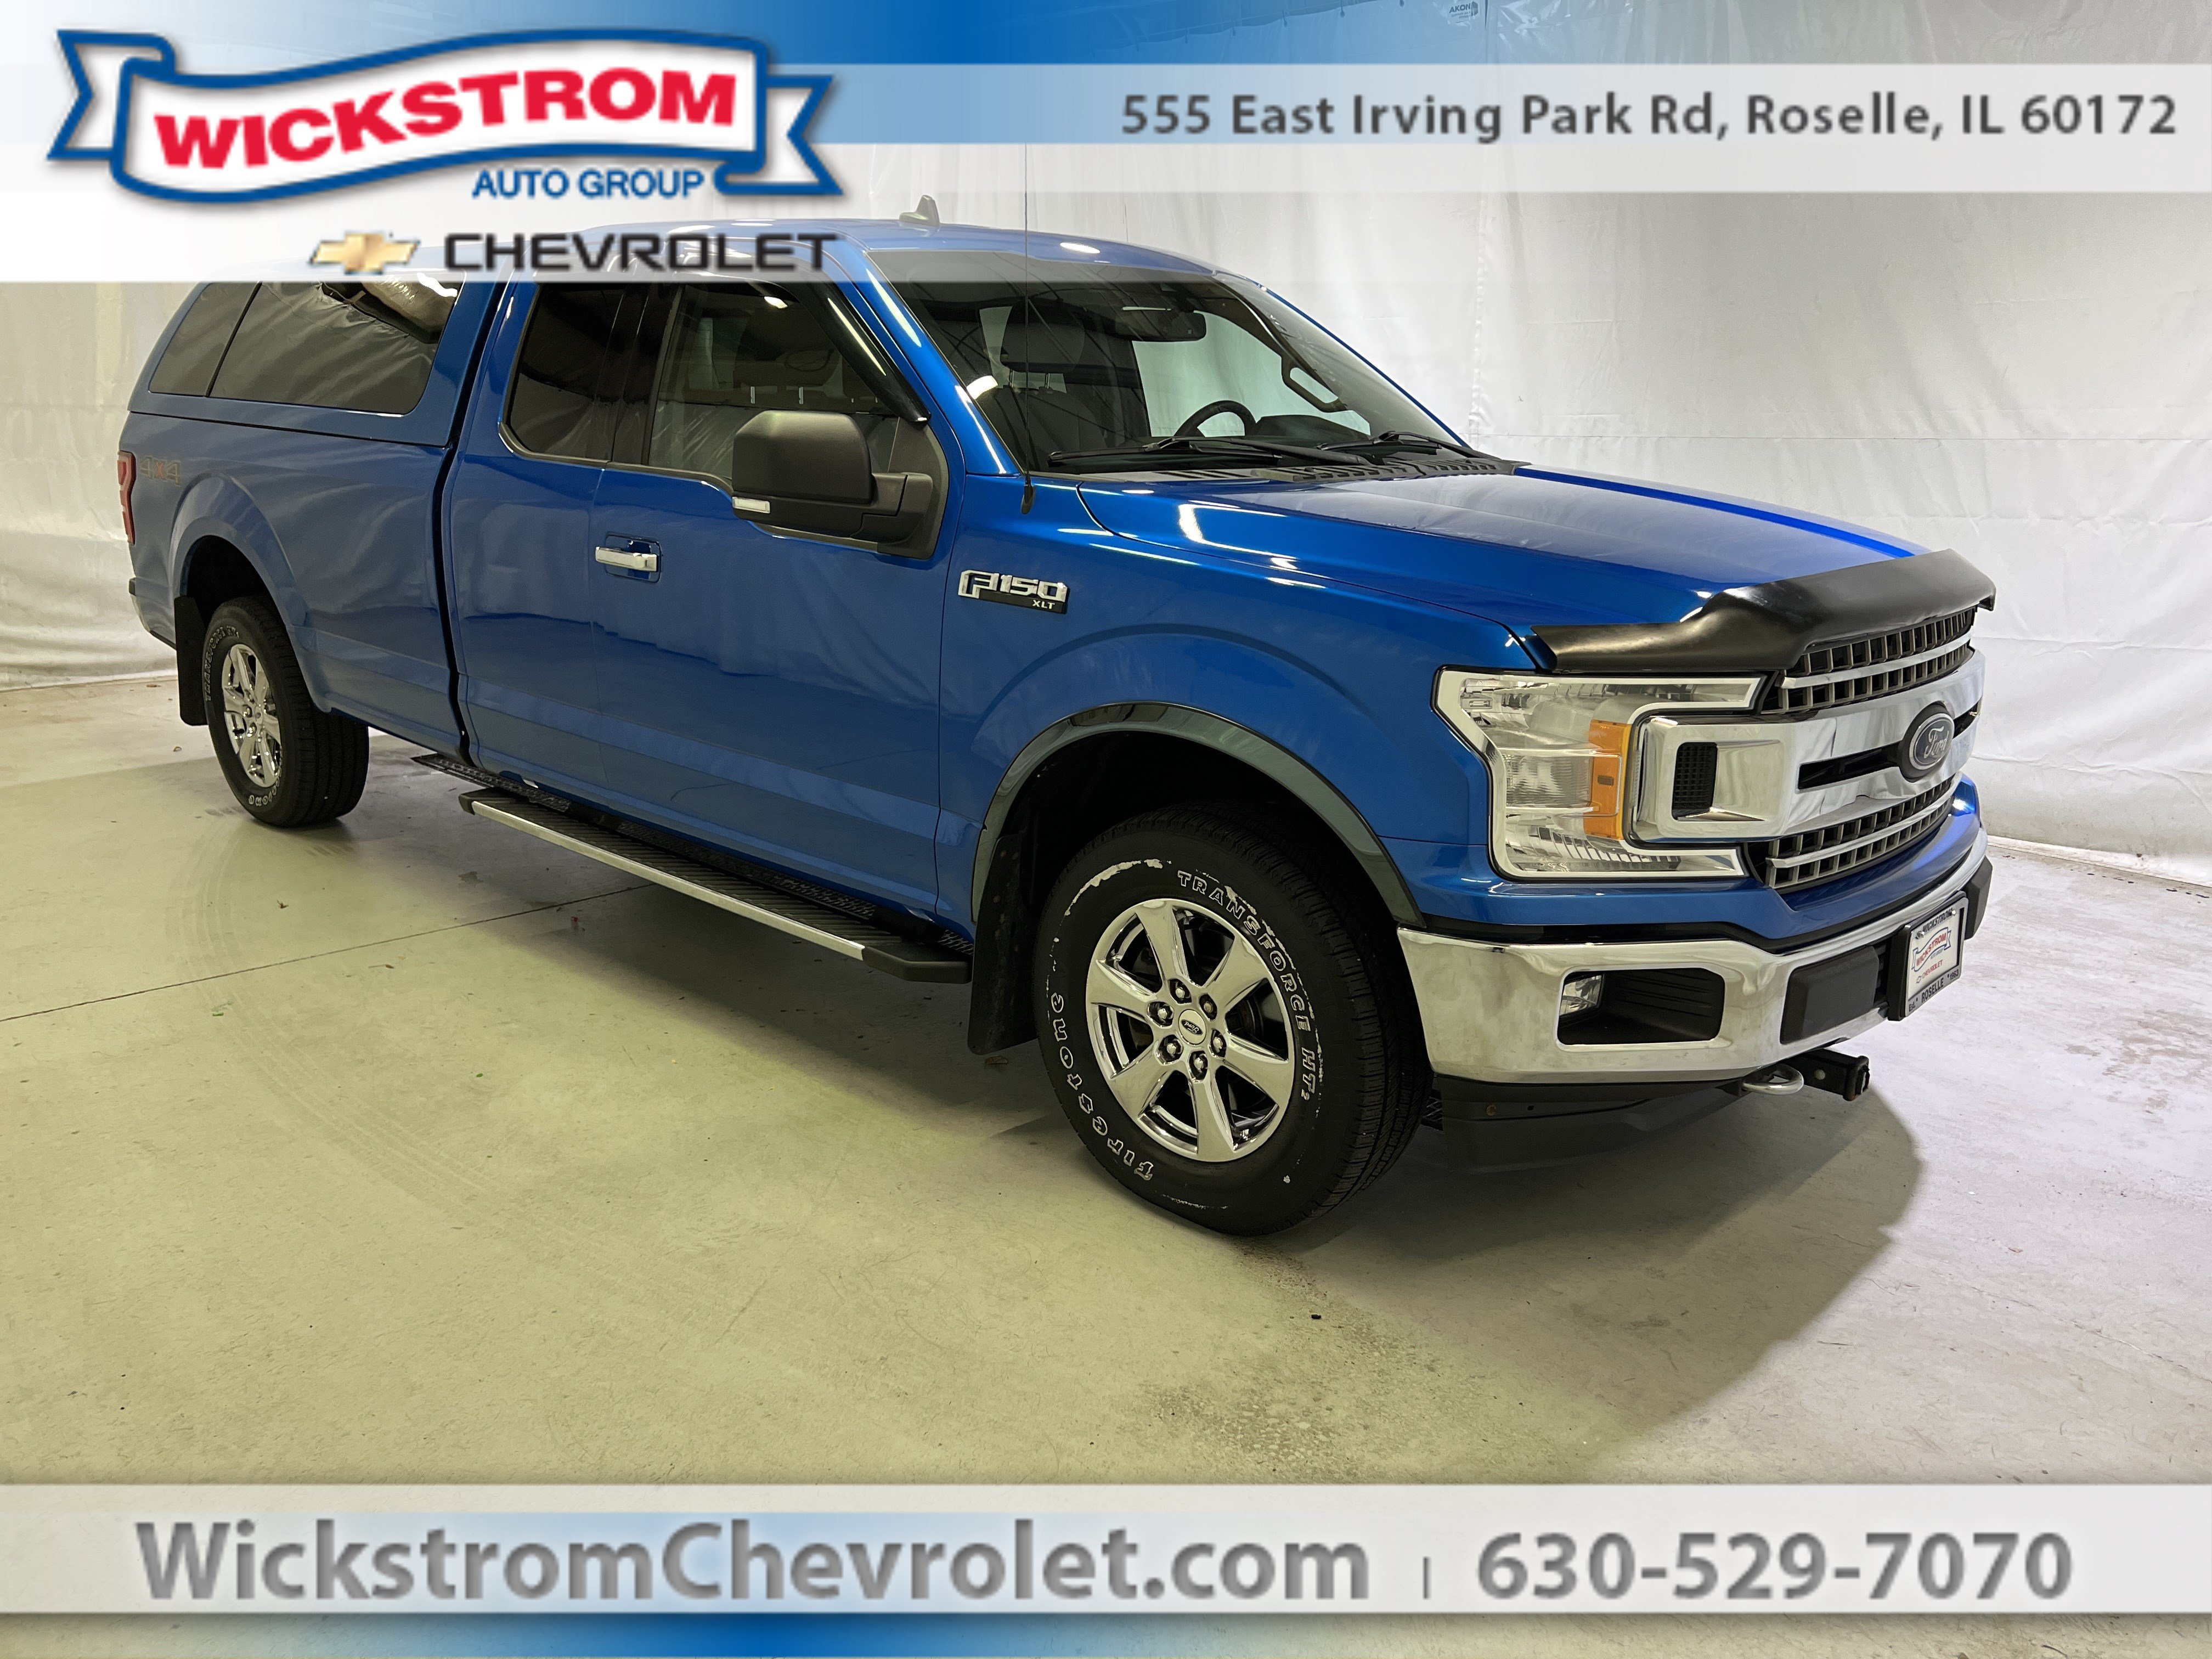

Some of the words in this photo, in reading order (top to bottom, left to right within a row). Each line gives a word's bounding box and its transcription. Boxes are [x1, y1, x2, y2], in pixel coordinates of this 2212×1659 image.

[1448, 3, 1471, 14] AKON
[1032, 599, 1056, 610] XLT
[1923, 725, 1950, 759] Ford
[1176, 870, 1310, 1030] TRANSFORCE
[1916, 932, 1947, 967] WICKSTROM
[1922, 959, 1943, 979] CHEVROLET
[1921, 977, 1944, 1003] ROSELLE
[1183, 1020, 1200, 1034] Ford
[1050, 991, 1157, 1182] Firestone
